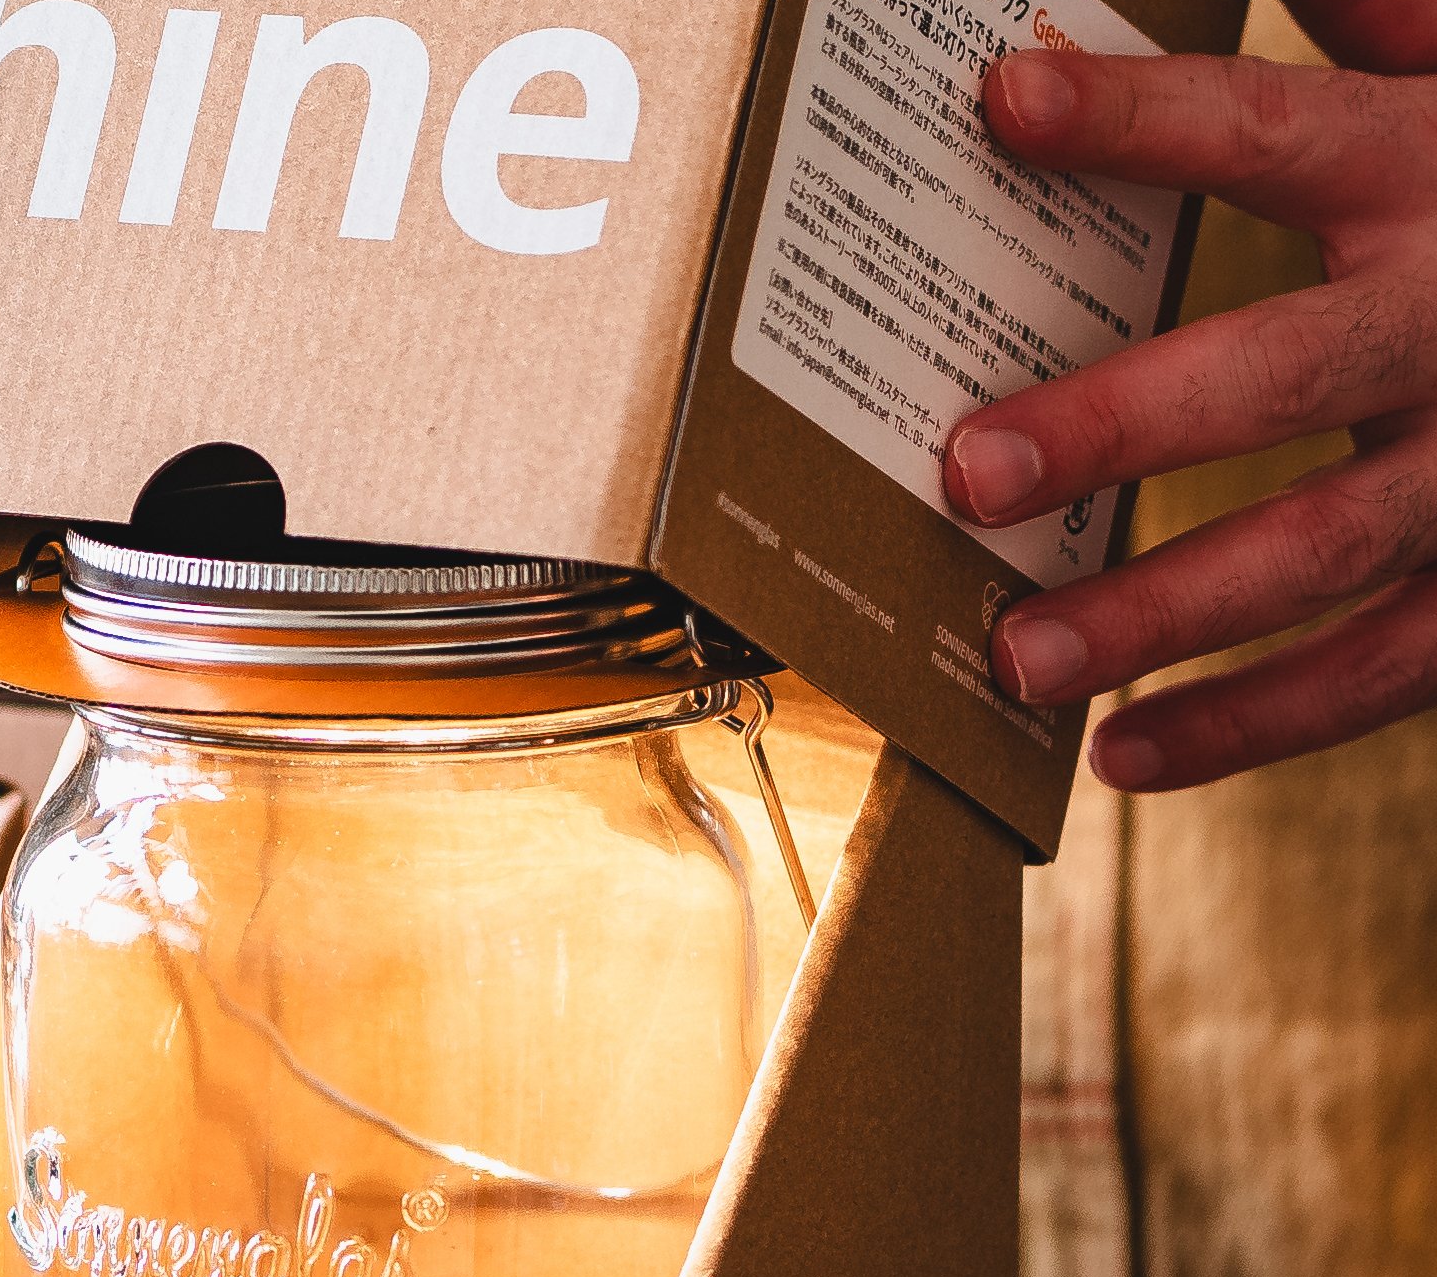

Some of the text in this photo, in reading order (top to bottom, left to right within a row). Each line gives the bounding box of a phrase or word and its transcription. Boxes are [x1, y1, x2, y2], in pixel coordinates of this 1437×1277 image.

[794, 549, 896, 634] www.sonnenglas.net
[931, 650, 956, 678] made
[956, 665, 976, 693] with
[976, 678, 995, 707] love
[993, 694, 1003, 713] in
[935, 624, 992, 679] SONNENGLA
